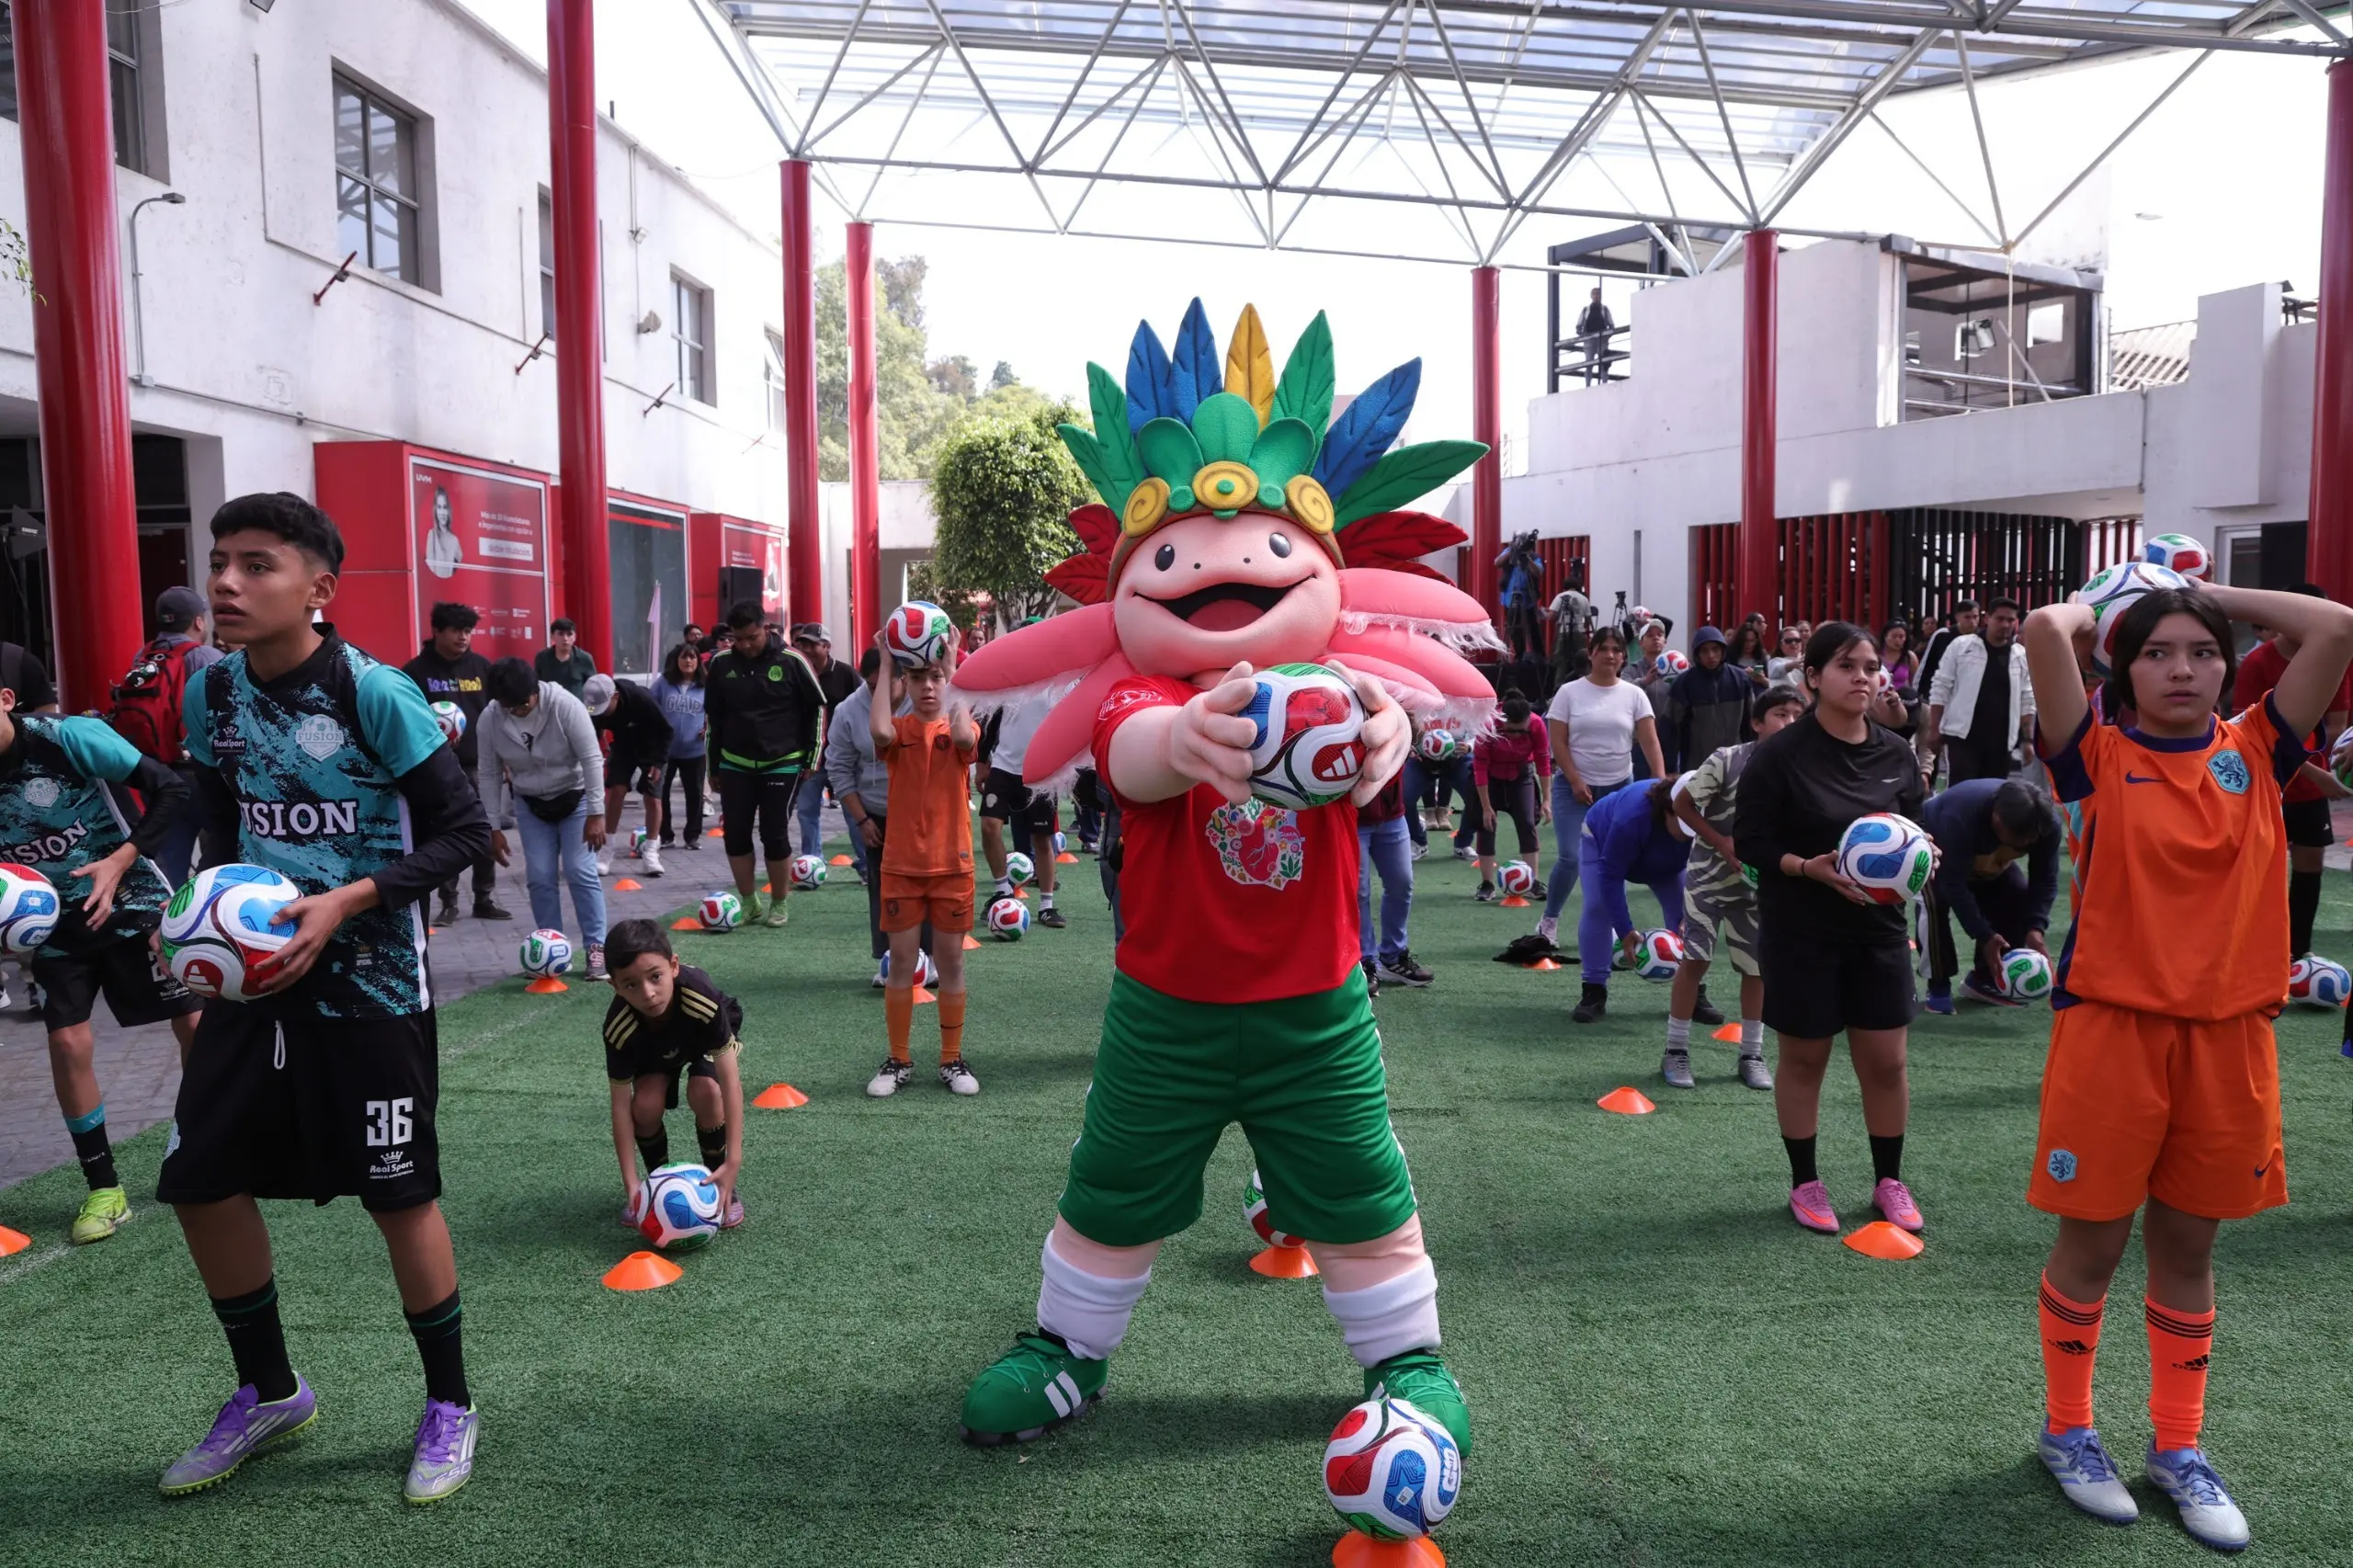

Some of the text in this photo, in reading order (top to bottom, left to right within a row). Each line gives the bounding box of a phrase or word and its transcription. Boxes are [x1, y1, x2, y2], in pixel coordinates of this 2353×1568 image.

[416, 473, 432, 483] UVM
[297, 732, 343, 742] FUSION
[241, 801, 357, 835] USION
[366, 1096, 414, 1146] 36
[369, 1160, 415, 1174] Real Sport
